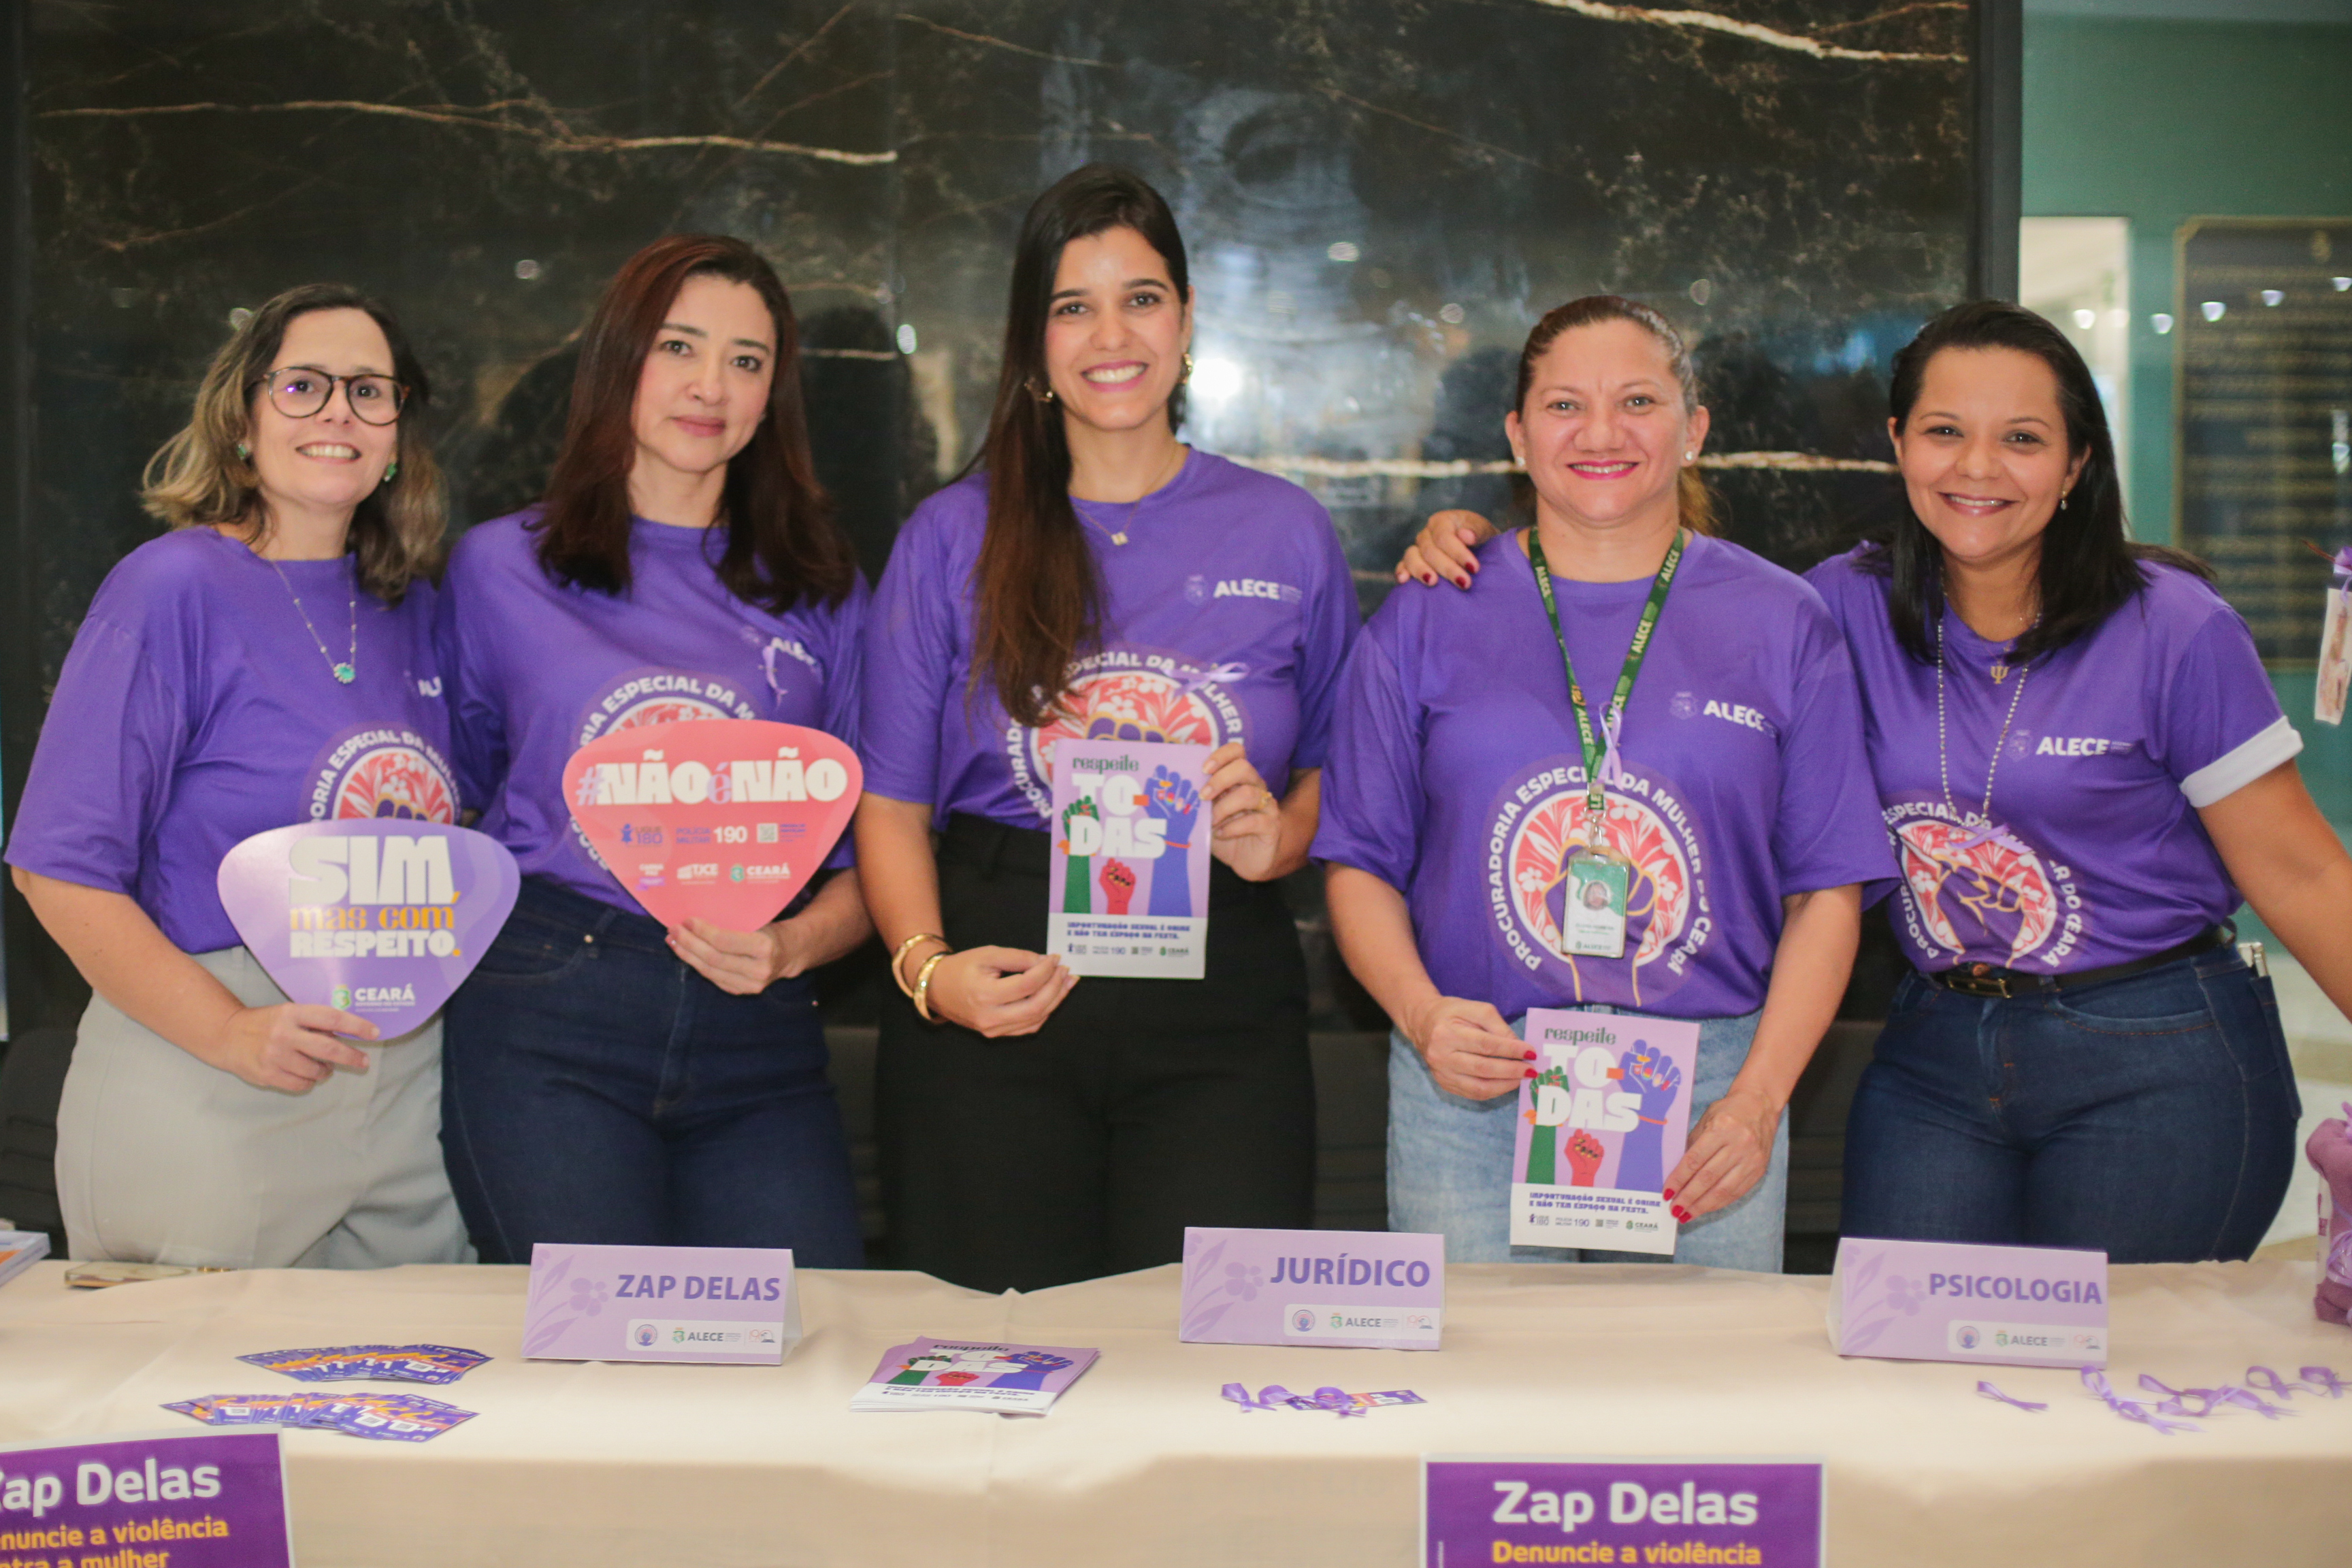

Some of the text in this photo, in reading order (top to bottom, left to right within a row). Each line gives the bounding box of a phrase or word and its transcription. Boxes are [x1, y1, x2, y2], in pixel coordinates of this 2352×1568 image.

[1661, 549, 1680, 582] ALECE
[1213, 578, 1281, 600] ALECE
[1631, 619, 1654, 653] ALECE
[1146, 654, 1176, 670] DA
[602, 675, 702, 714] ESPECIAL
[705, 683, 736, 708] DA
[1576, 708, 1595, 745] ALECE
[1703, 700, 1765, 732] ALECE
[327, 730, 402, 770] ESPECIAL
[2036, 736, 2110, 757] ALECE
[1073, 755, 1139, 774] respeite
[636, 832, 664, 845] 180
[713, 826, 748, 844] 190
[1069, 815, 1168, 859] DAS
[747, 863, 790, 875] CEARÁ
[1488, 800, 1543, 971] PROCURADORIA
[1622, 771, 1650, 797] DA
[1652, 789, 1701, 875] MULHER
[2061, 883, 2082, 909] DO
[290, 906, 455, 930] mas com
[290, 930, 461, 958] RESPEITO.
[355, 983, 416, 1002] CEARÁ
[1544, 1027, 1616, 1046] respeite
[1535, 1085, 1642, 1132] DAS
[1574, 1219, 1590, 1227] 190
[1270, 1253, 1430, 1288] JURÍDICO
[615, 1275, 781, 1301] ZAP DELAS
[1929, 1273, 2103, 1305] PSICOLOGIA
[1345, 1318, 1382, 1327] ALECE
[687, 1332, 724, 1341] ALECE
[2010, 1335, 2048, 1346] ALECE
[909, 1360, 1030, 1373] DAS
[0, 1458, 221, 1518] ap Delas
[1492, 1482, 1759, 1532] Zap Delas
[0, 1516, 228, 1550] nuncie a violência
[80, 1550, 169, 1568] mulher
[1492, 1541, 1762, 1565] Denuncie a violência
